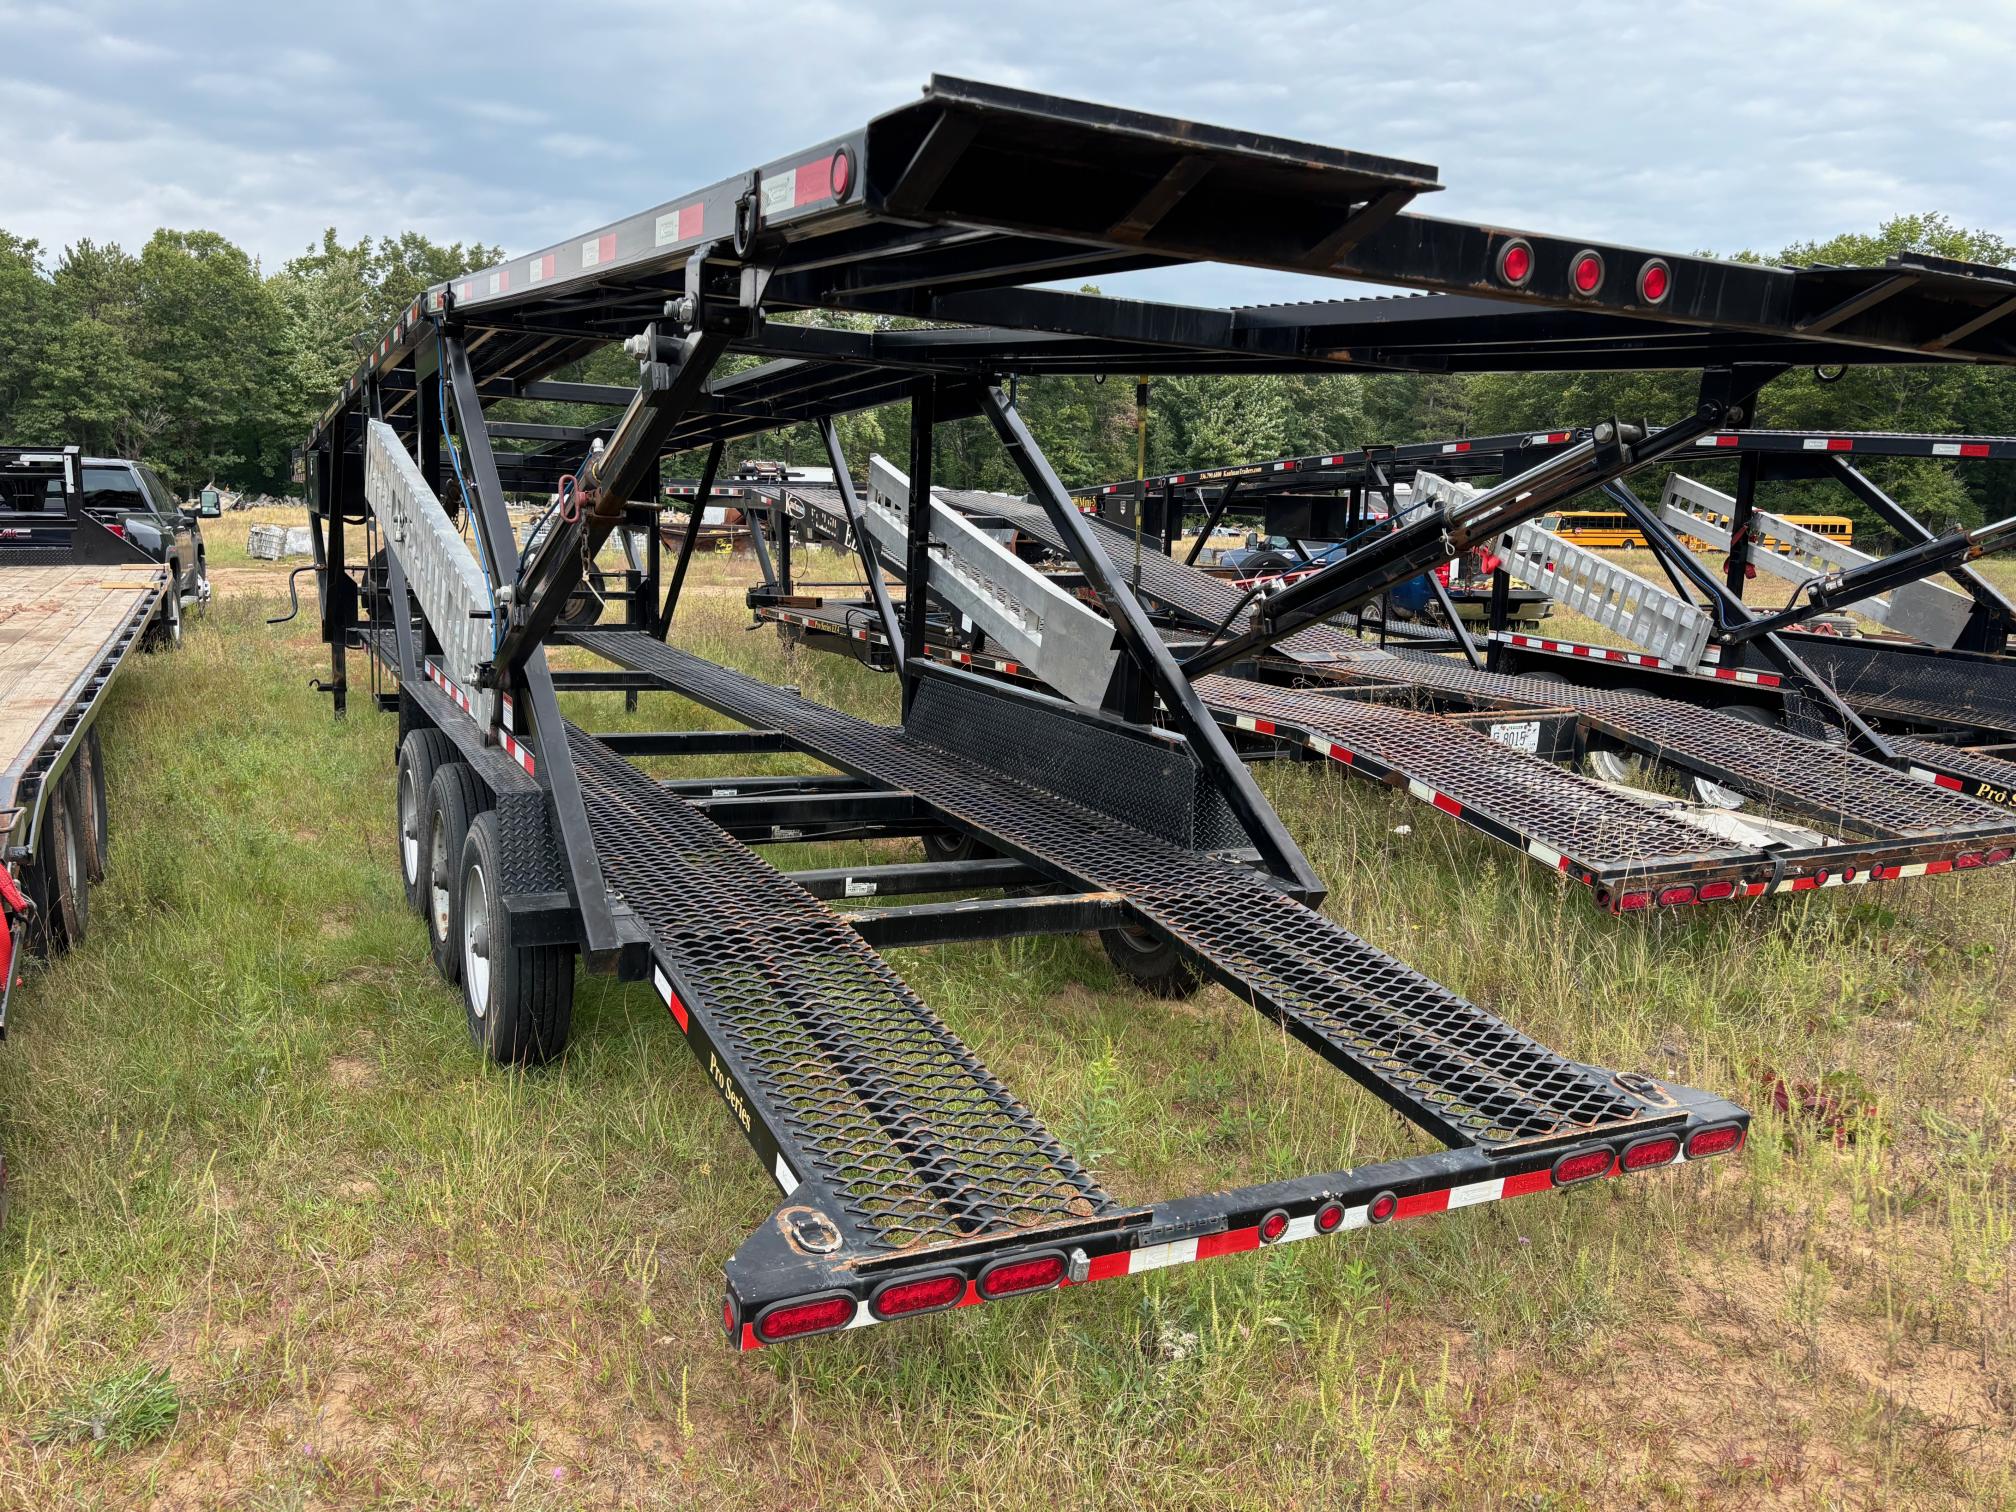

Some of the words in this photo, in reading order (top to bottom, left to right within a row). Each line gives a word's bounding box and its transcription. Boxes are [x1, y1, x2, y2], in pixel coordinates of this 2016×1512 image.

[1975, 782, 2007, 803] Pro
[709, 1051, 725, 1089] Pro
[725, 1077, 751, 1133] Series
